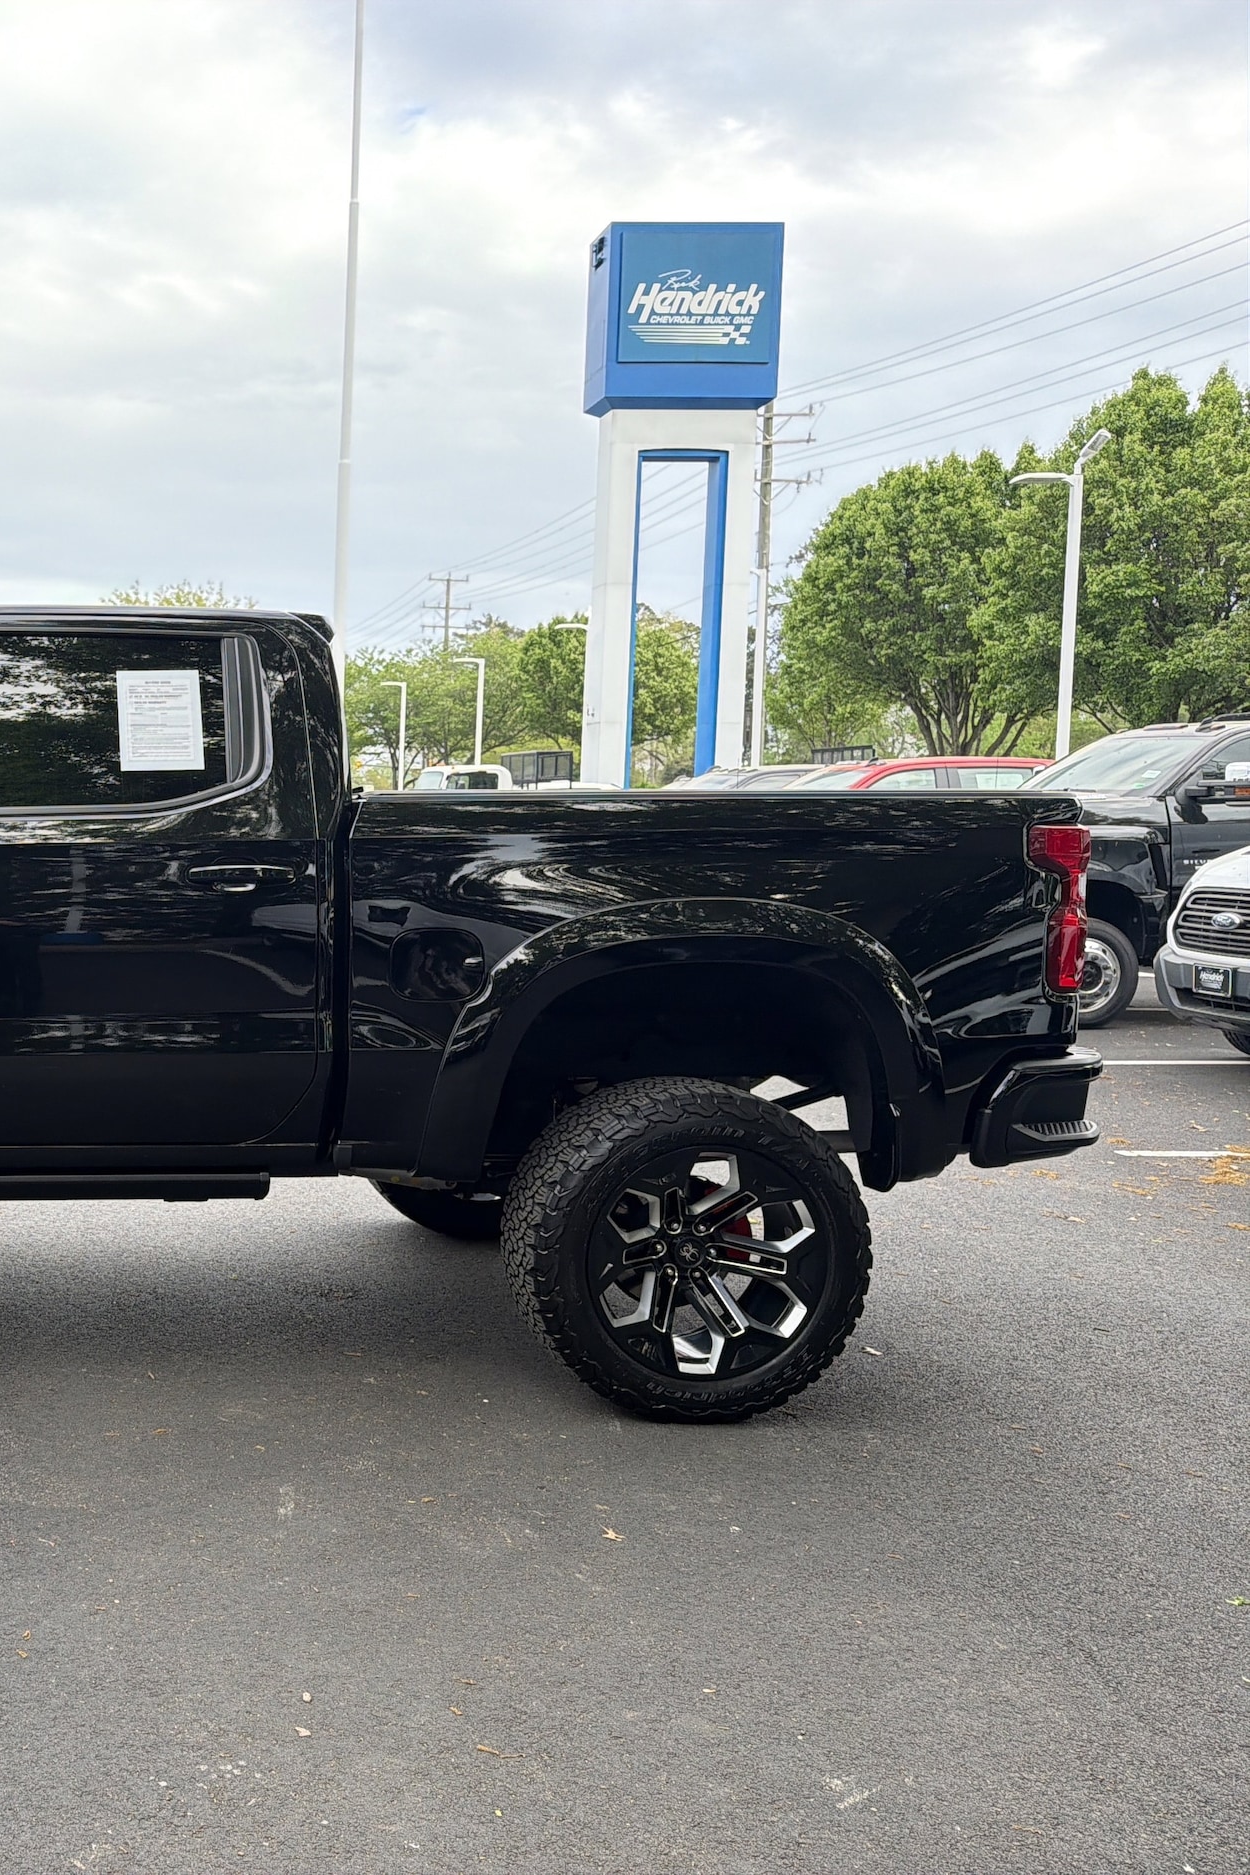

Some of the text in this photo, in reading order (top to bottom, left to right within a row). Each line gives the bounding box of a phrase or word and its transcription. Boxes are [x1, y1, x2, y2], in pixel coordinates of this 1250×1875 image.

[627, 282, 766, 323] Hendrick
[650, 315, 755, 324] CHEVROLET BUICK GMC
